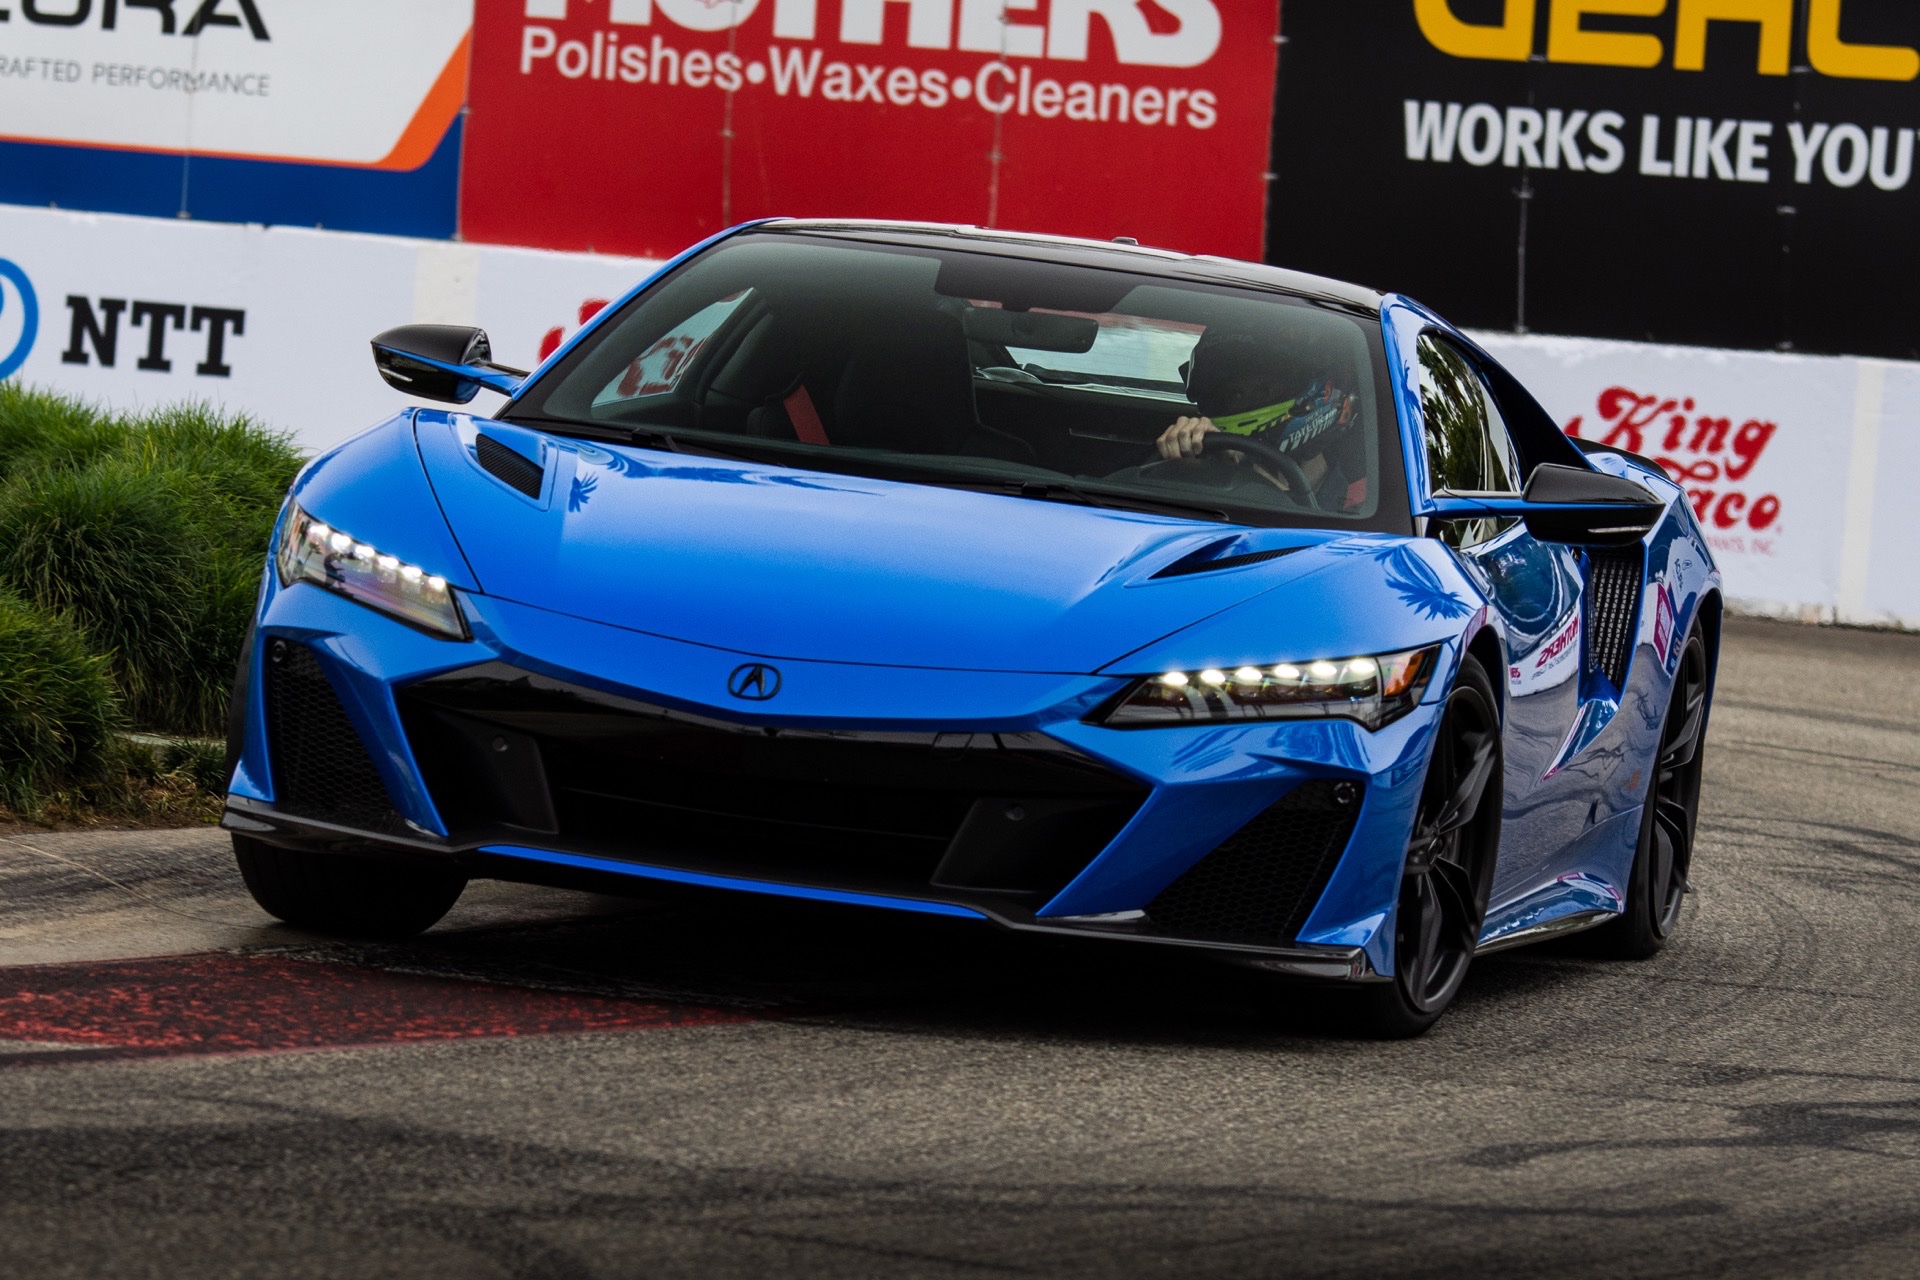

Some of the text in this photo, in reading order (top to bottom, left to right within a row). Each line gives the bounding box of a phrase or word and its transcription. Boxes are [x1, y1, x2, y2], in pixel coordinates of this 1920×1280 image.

[92, 63, 271, 96] PERFORMANCE
[521, 25, 743, 92] Polishes
[768, 46, 948, 107] Waxes
[975, 61, 1217, 129] Cleaners
[1404, 99, 1626, 173] WORKS
[1640, 114, 1774, 183] LIKE
[61, 295, 247, 378] NTT
[1563, 385, 1778, 481] King
